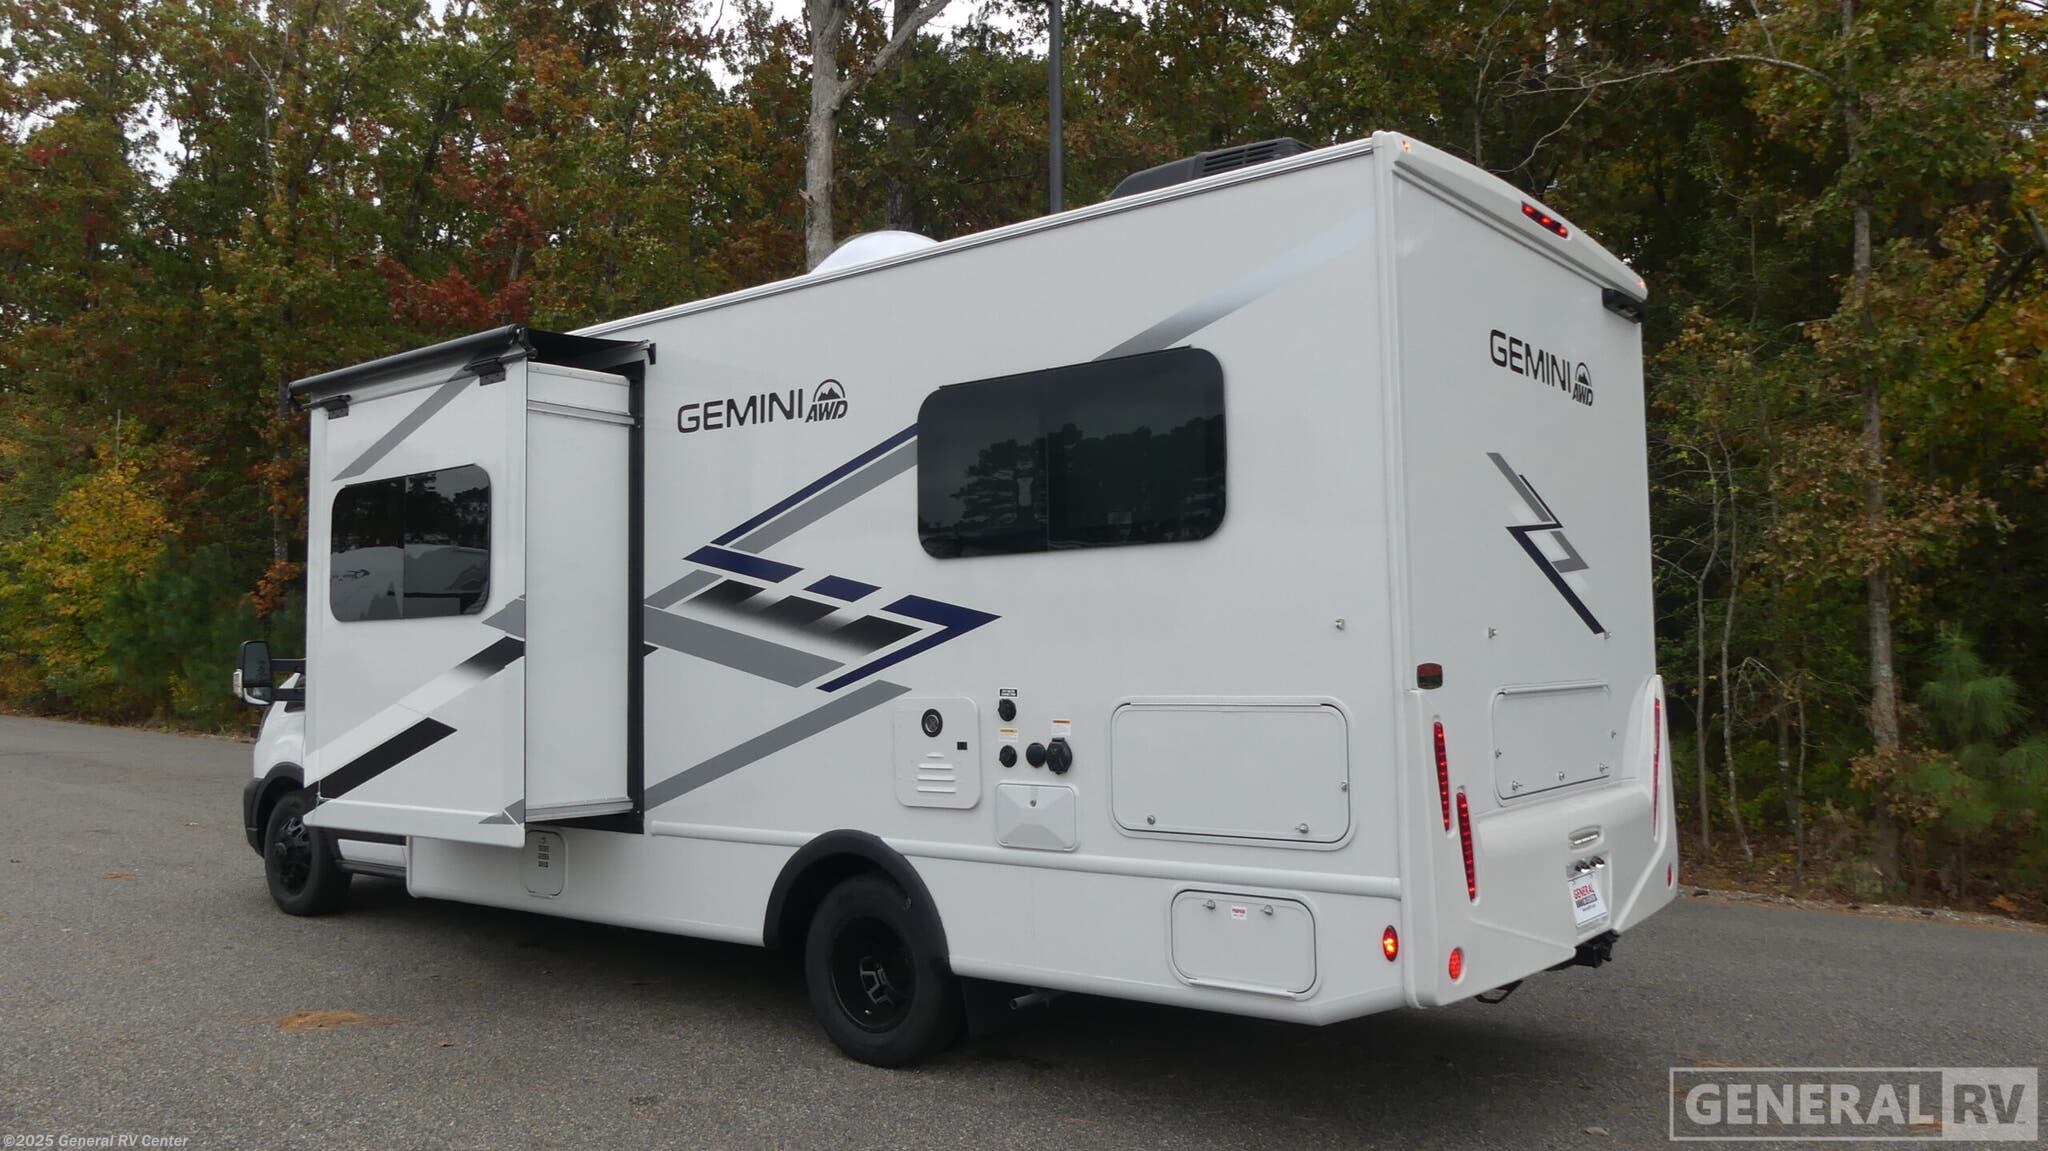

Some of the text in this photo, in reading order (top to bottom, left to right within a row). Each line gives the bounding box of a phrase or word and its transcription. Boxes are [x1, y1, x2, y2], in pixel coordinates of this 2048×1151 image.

[1490, 329, 1594, 407] GEMINI AWD
[678, 388, 849, 433] GEMINI AWD
